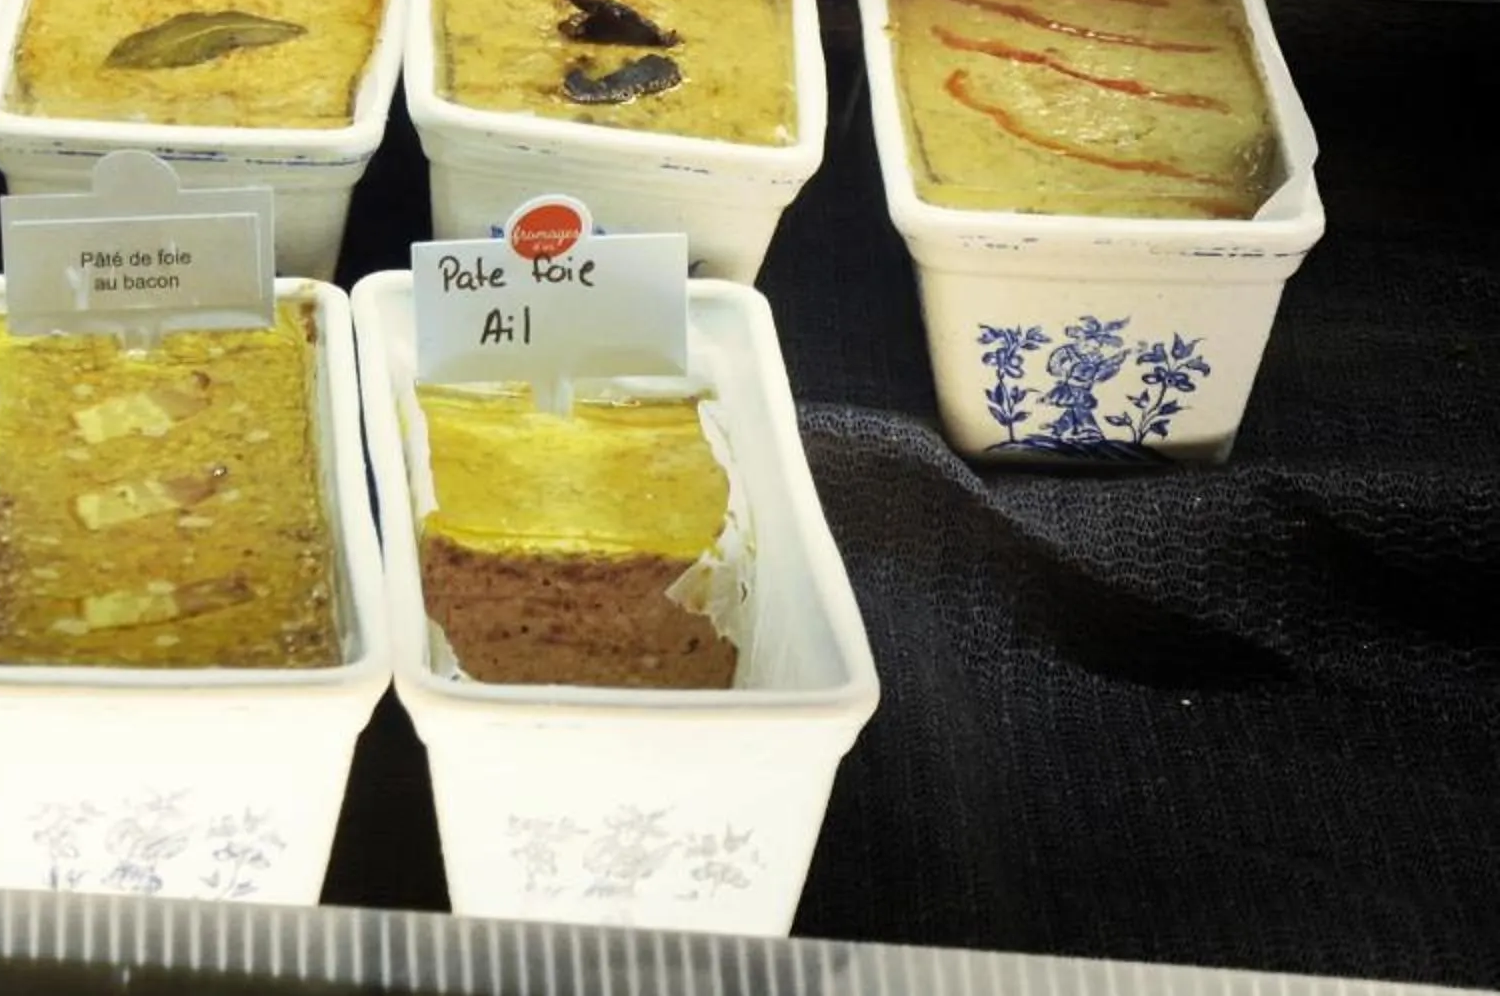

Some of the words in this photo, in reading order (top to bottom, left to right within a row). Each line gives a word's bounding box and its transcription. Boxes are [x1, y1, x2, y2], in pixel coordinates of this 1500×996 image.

[81, 250, 123, 268] Pâté
[129, 250, 152, 267] de
[158, 248, 192, 266] foie
[438, 255, 507, 293] Pate
[531, 252, 596, 287] foie
[94, 277, 117, 291] au
[123, 273, 180, 290] bacon
[480, 306, 530, 345] Ail
